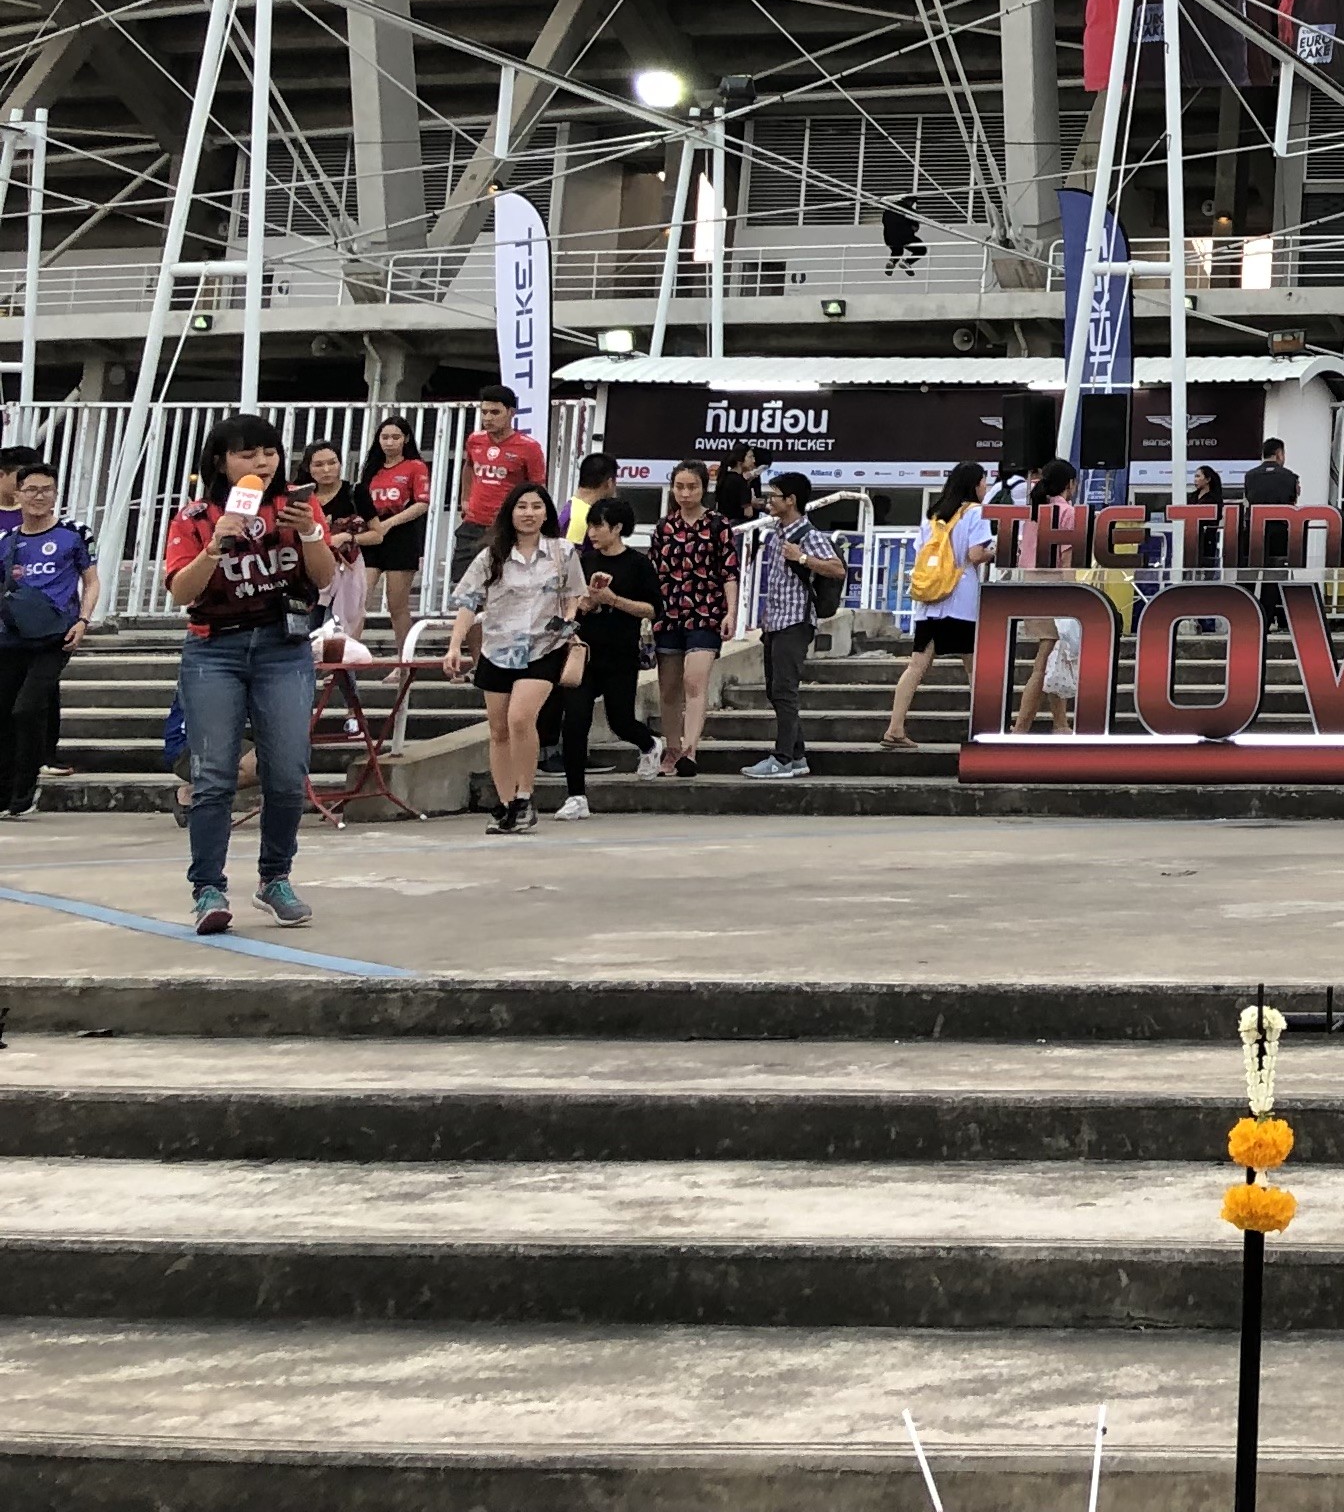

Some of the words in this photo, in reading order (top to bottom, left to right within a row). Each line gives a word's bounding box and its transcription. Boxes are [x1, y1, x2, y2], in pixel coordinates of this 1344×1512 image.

[515, 227, 533, 389] TICKET
[705, 400, 829, 435] ทีมเยือน
[695, 438, 737, 452] AWAY
[784, 438, 835, 452] TICKET
[976, 440, 1002, 448] BANG
[616, 465, 650, 478] true
[234, 499, 252, 510] 16
[981, 503, 1149, 569] THE
[26, 561, 56, 576] SCG
[218, 546, 299, 583] true
